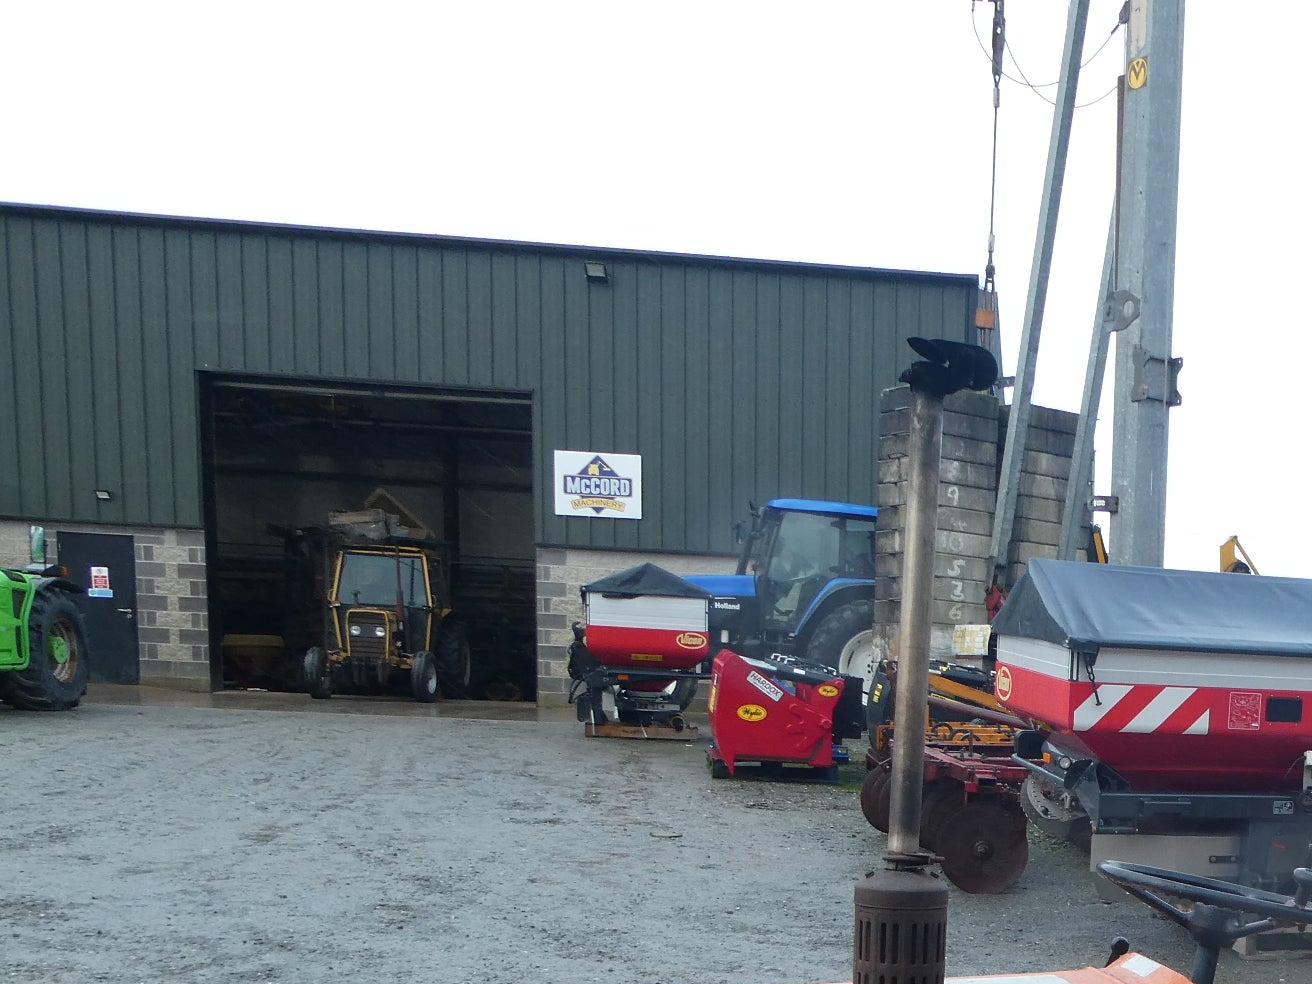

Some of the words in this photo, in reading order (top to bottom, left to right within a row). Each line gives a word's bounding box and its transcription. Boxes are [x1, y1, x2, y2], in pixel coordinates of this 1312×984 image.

[572, 499, 624, 509] MACHINERY
[947, 486, 959, 506] 9
[950, 580, 965, 601] 3
[714, 601, 740, 610] Holland
[948, 603, 962, 620] 6
[750, 672, 780, 697] HARDOX
